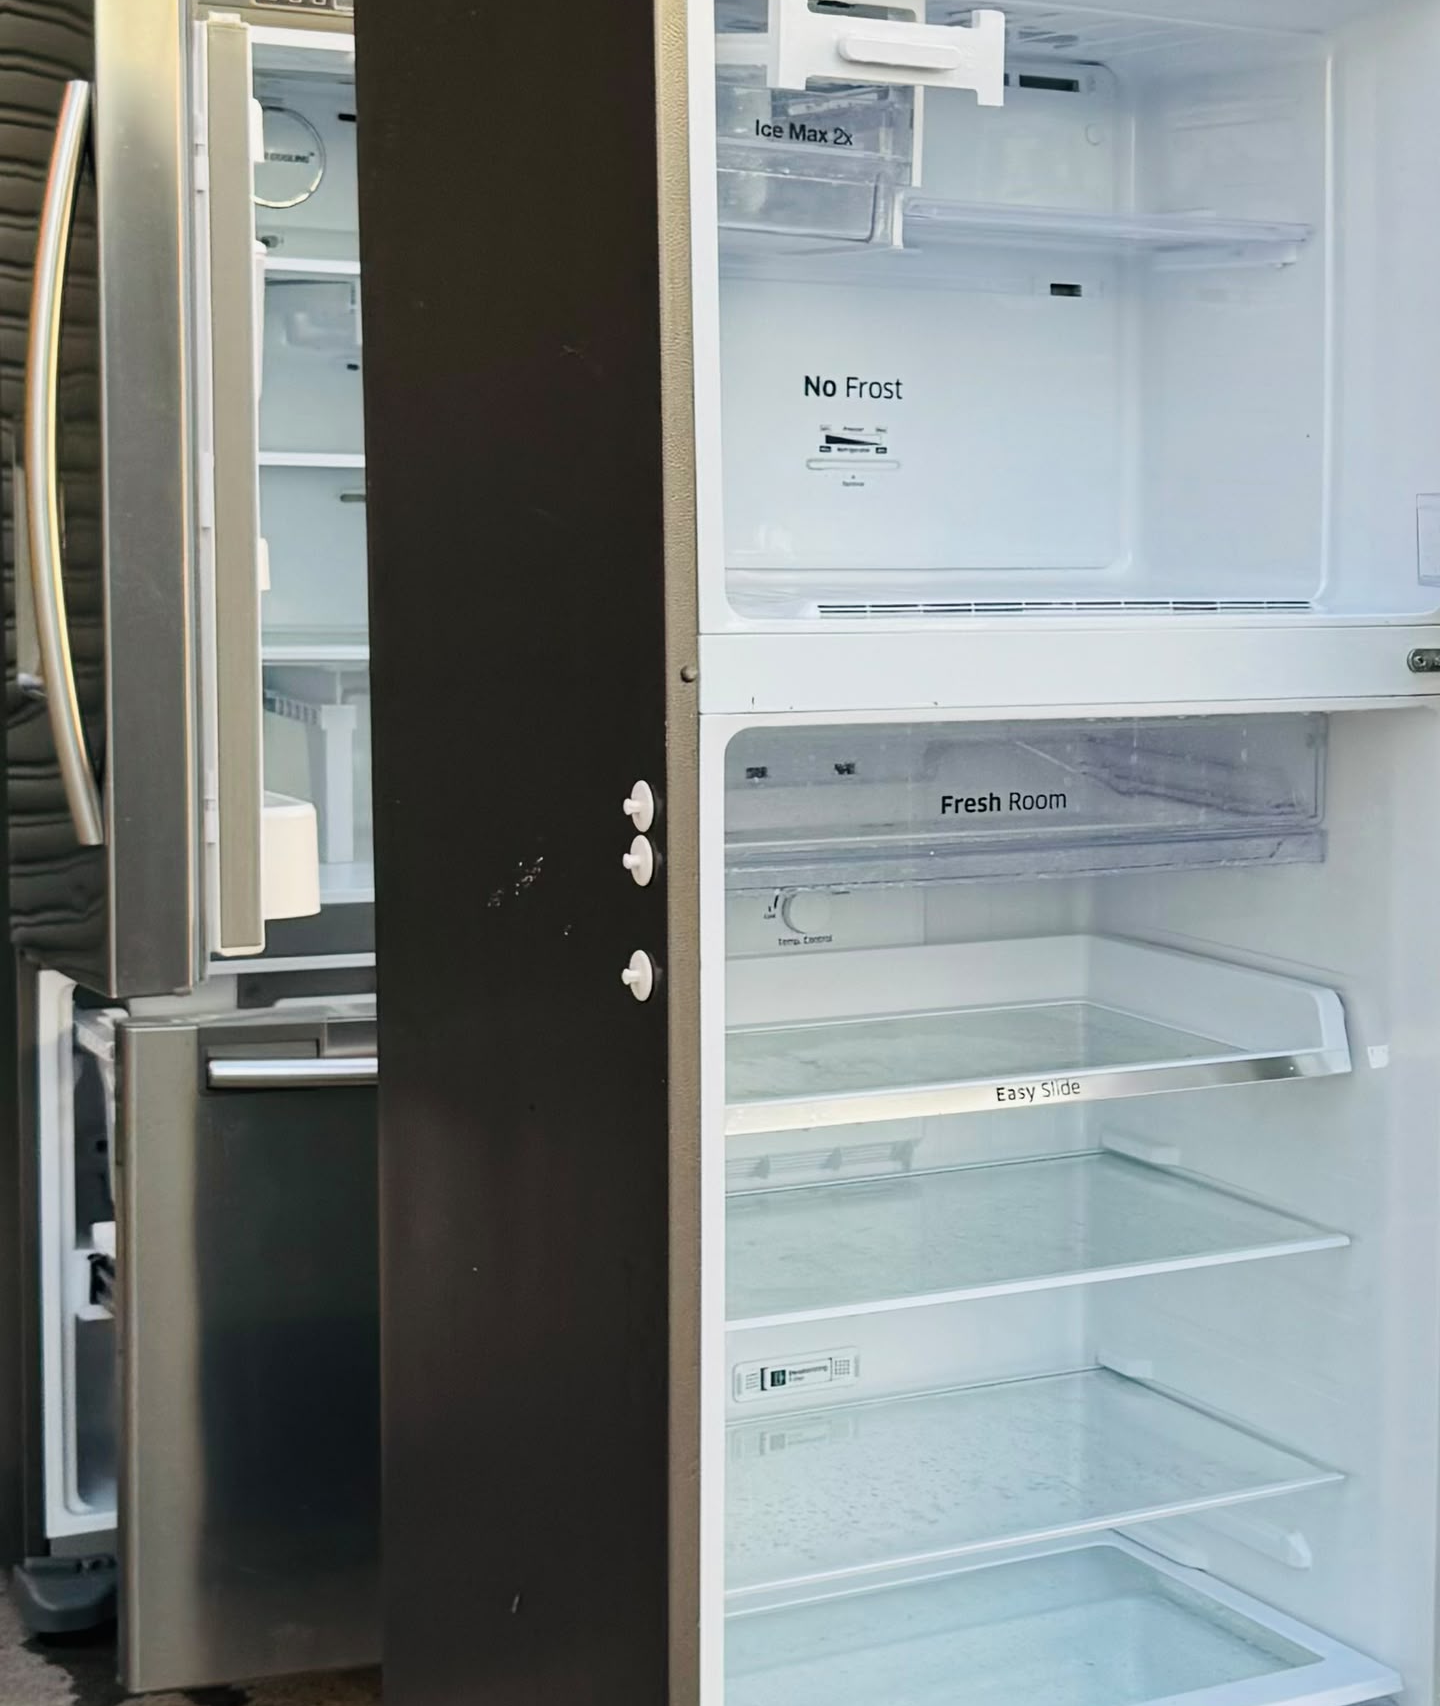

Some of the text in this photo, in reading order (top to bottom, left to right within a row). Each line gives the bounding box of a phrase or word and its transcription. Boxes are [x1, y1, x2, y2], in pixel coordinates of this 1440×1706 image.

[755, 118, 853, 146] Ice Max 2x
[804, 375, 903, 400] No Frost
[941, 792, 1067, 814] Fresh Room
[996, 1079, 1081, 1103] Easy Slide
